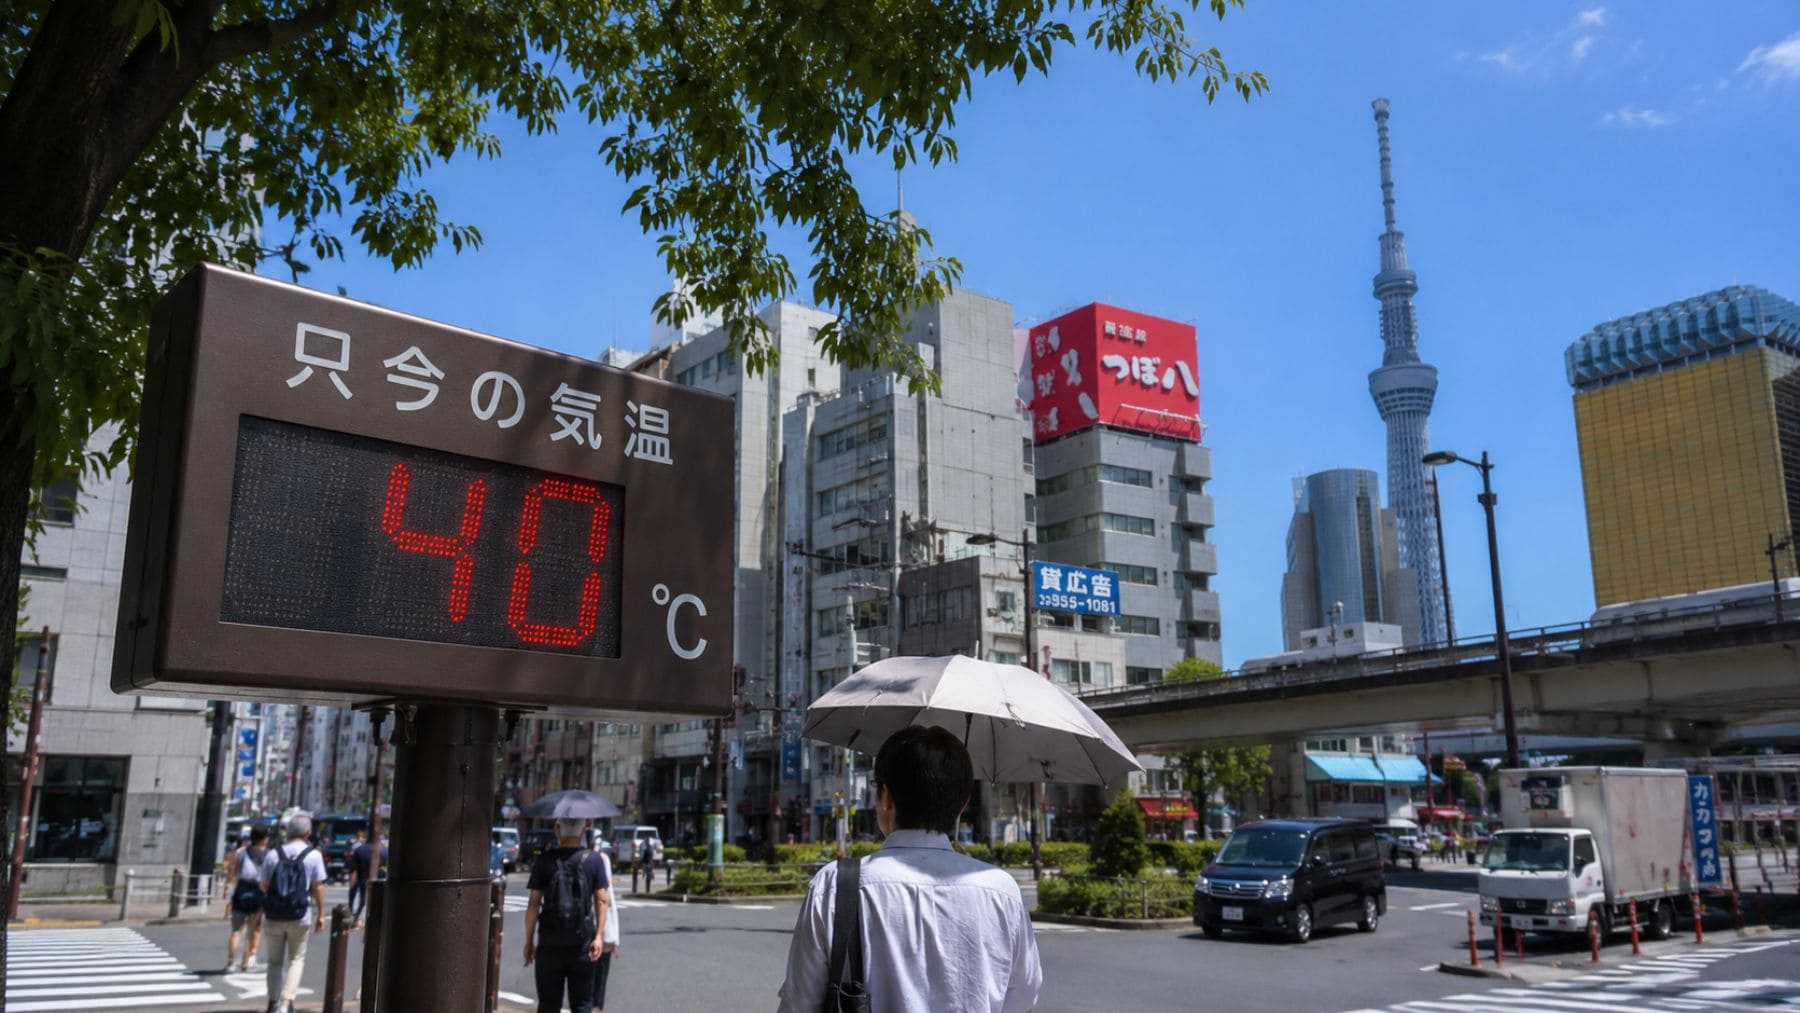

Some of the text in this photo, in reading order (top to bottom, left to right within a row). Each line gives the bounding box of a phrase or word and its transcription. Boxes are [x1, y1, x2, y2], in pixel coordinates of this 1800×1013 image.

[286, 321, 674, 466] 只今の気温
[1102, 354, 1199, 397] つぼ八
[381, 462, 611, 647] 40
